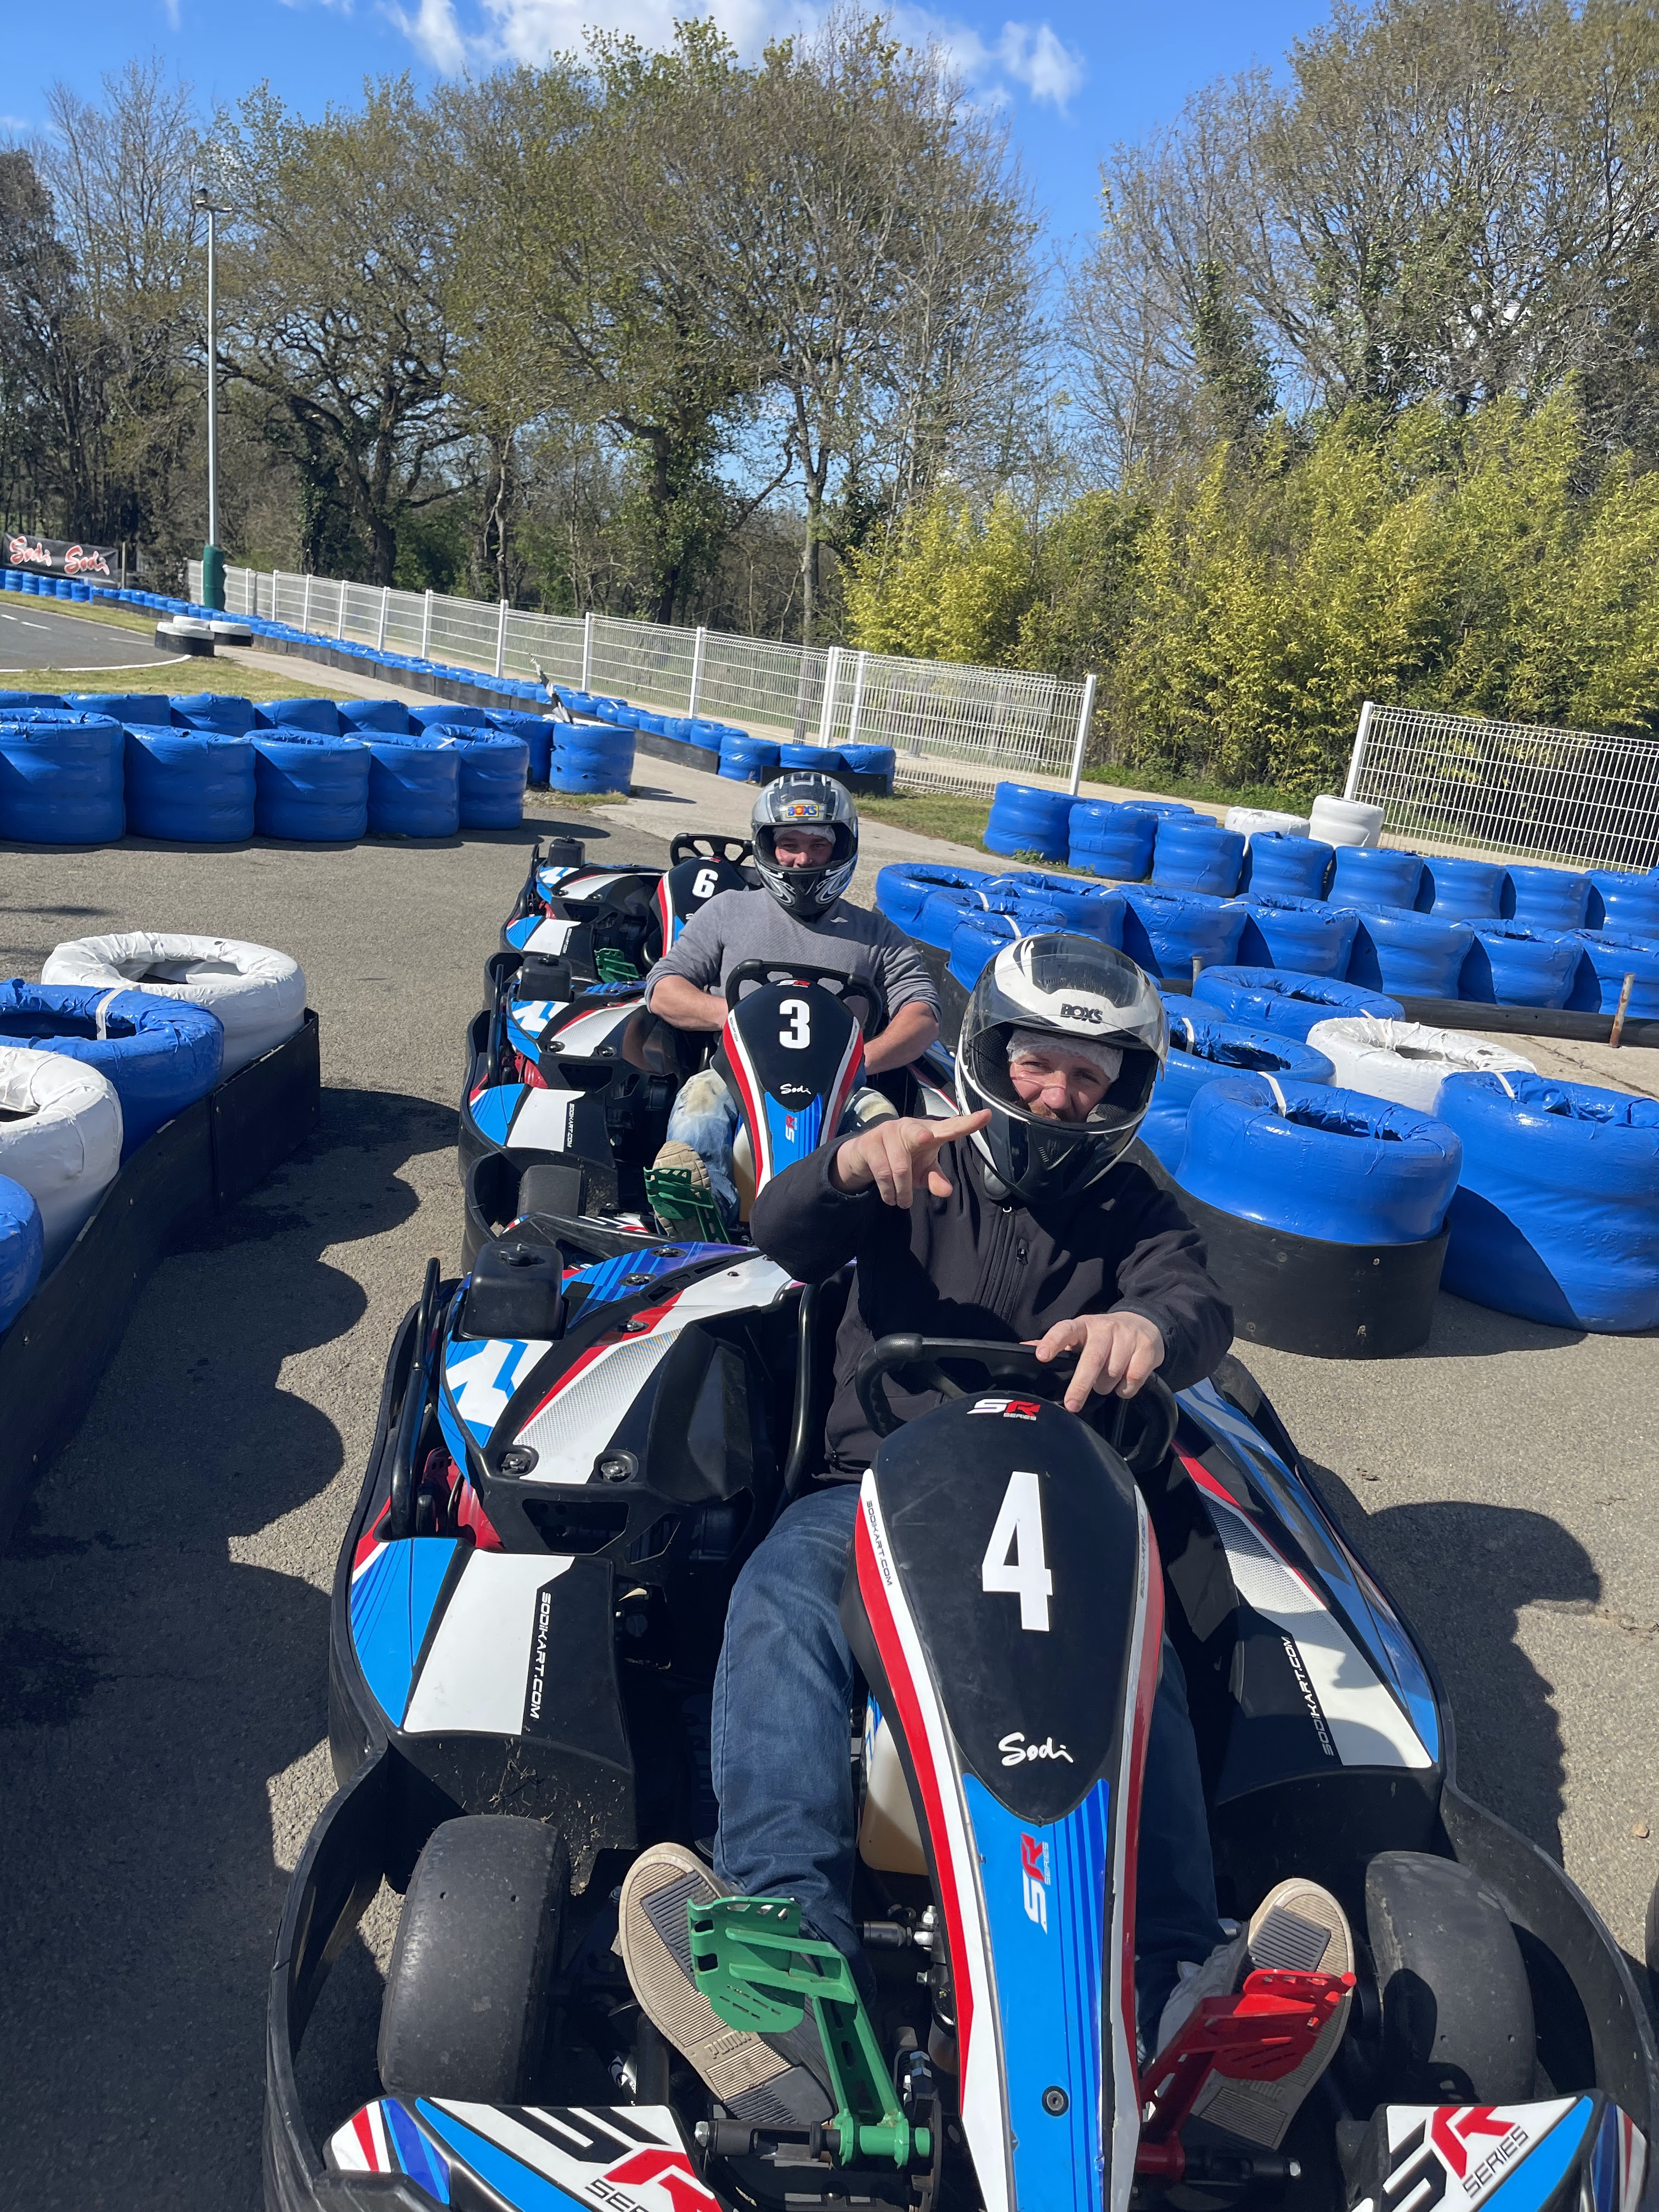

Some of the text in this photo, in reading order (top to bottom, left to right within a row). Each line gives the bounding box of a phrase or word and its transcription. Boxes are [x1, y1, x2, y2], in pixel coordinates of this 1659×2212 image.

[9, 536, 110, 575] Sodi Sodi
[692, 868, 718, 898] 6
[780, 999, 810, 1049] 3
[780, 1084, 811, 1094] Sodi
[967, 1398, 1041, 1417] SR
[981, 1470, 1053, 1632] 4
[998, 1732, 1074, 1766] Sodi
[1021, 1833, 1047, 1934] SR
[1042, 1841, 1051, 1886] SERIES
[1463, 2125, 1529, 2198] SERIES
